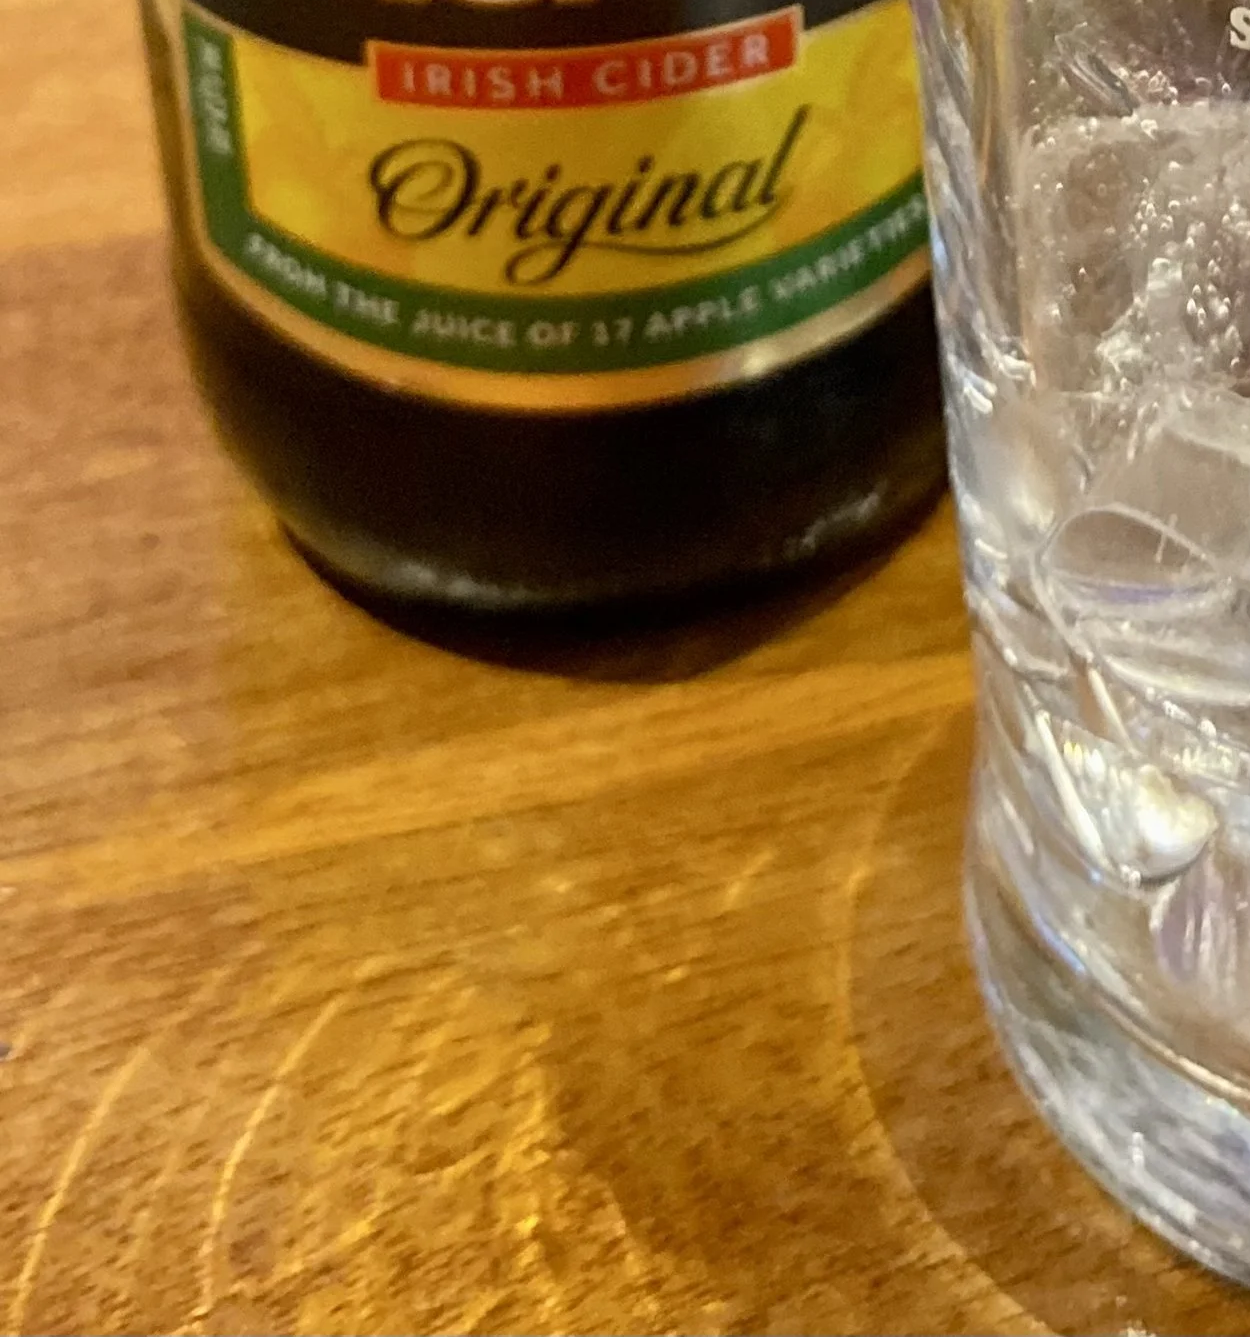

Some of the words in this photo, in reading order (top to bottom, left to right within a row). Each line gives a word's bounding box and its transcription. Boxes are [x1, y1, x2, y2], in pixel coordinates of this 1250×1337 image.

[401, 58, 566, 101] IRISH
[594, 33, 773, 98] CIDER
[368, 104, 810, 287] Original
[332, 279, 400, 326] THE
[411, 308, 516, 349] JUICE
[528, 320, 579, 349] OF
[644, 284, 761, 343] APPLE
